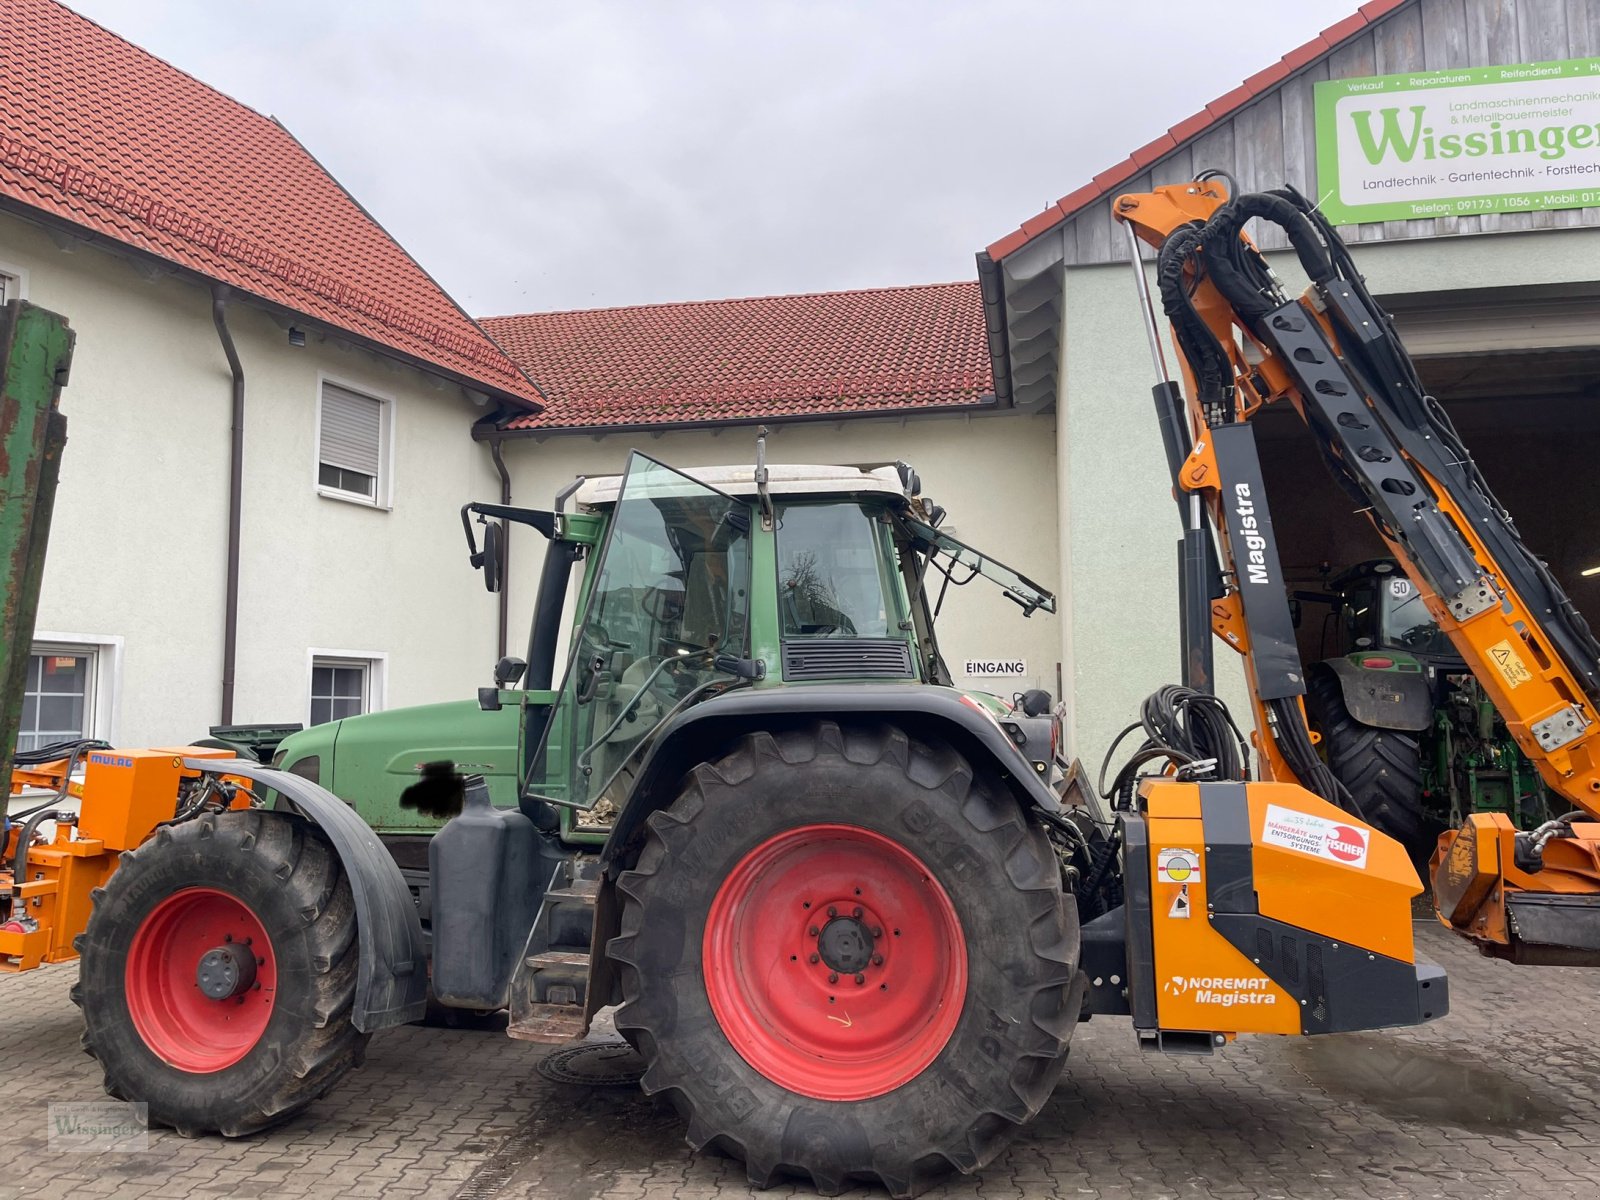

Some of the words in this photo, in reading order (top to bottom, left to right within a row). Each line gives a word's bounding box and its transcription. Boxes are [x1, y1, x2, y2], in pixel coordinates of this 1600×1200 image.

[1347, 81, 1384, 91] Verkauf
[1409, 74, 1471, 87] Reparaturen
[1500, 66, 1561, 79] Reifendienst
[1462, 107, 1573, 124] Metallbauermeister
[1363, 174, 1436, 190] Landtechnik
[1448, 168, 1534, 182] Gartentechnik
[1411, 202, 1453, 214] Telefon:
[1457, 200, 1492, 210] 09173
[1503, 197, 1530, 207] 1056
[1544, 193, 1578, 204] Mobil:
[1235, 483, 1269, 584] Magistra
[1393, 582, 1407, 594] 50
[966, 662, 1024, 673] EINGANG
[91, 754, 132, 767] MULAG
[1290, 841, 1320, 854] SYSTEME
[1327, 838, 1364, 857] FISCHER
[1189, 977, 1270, 990] NOREMAT
[1195, 990, 1276, 1007] Magistra
